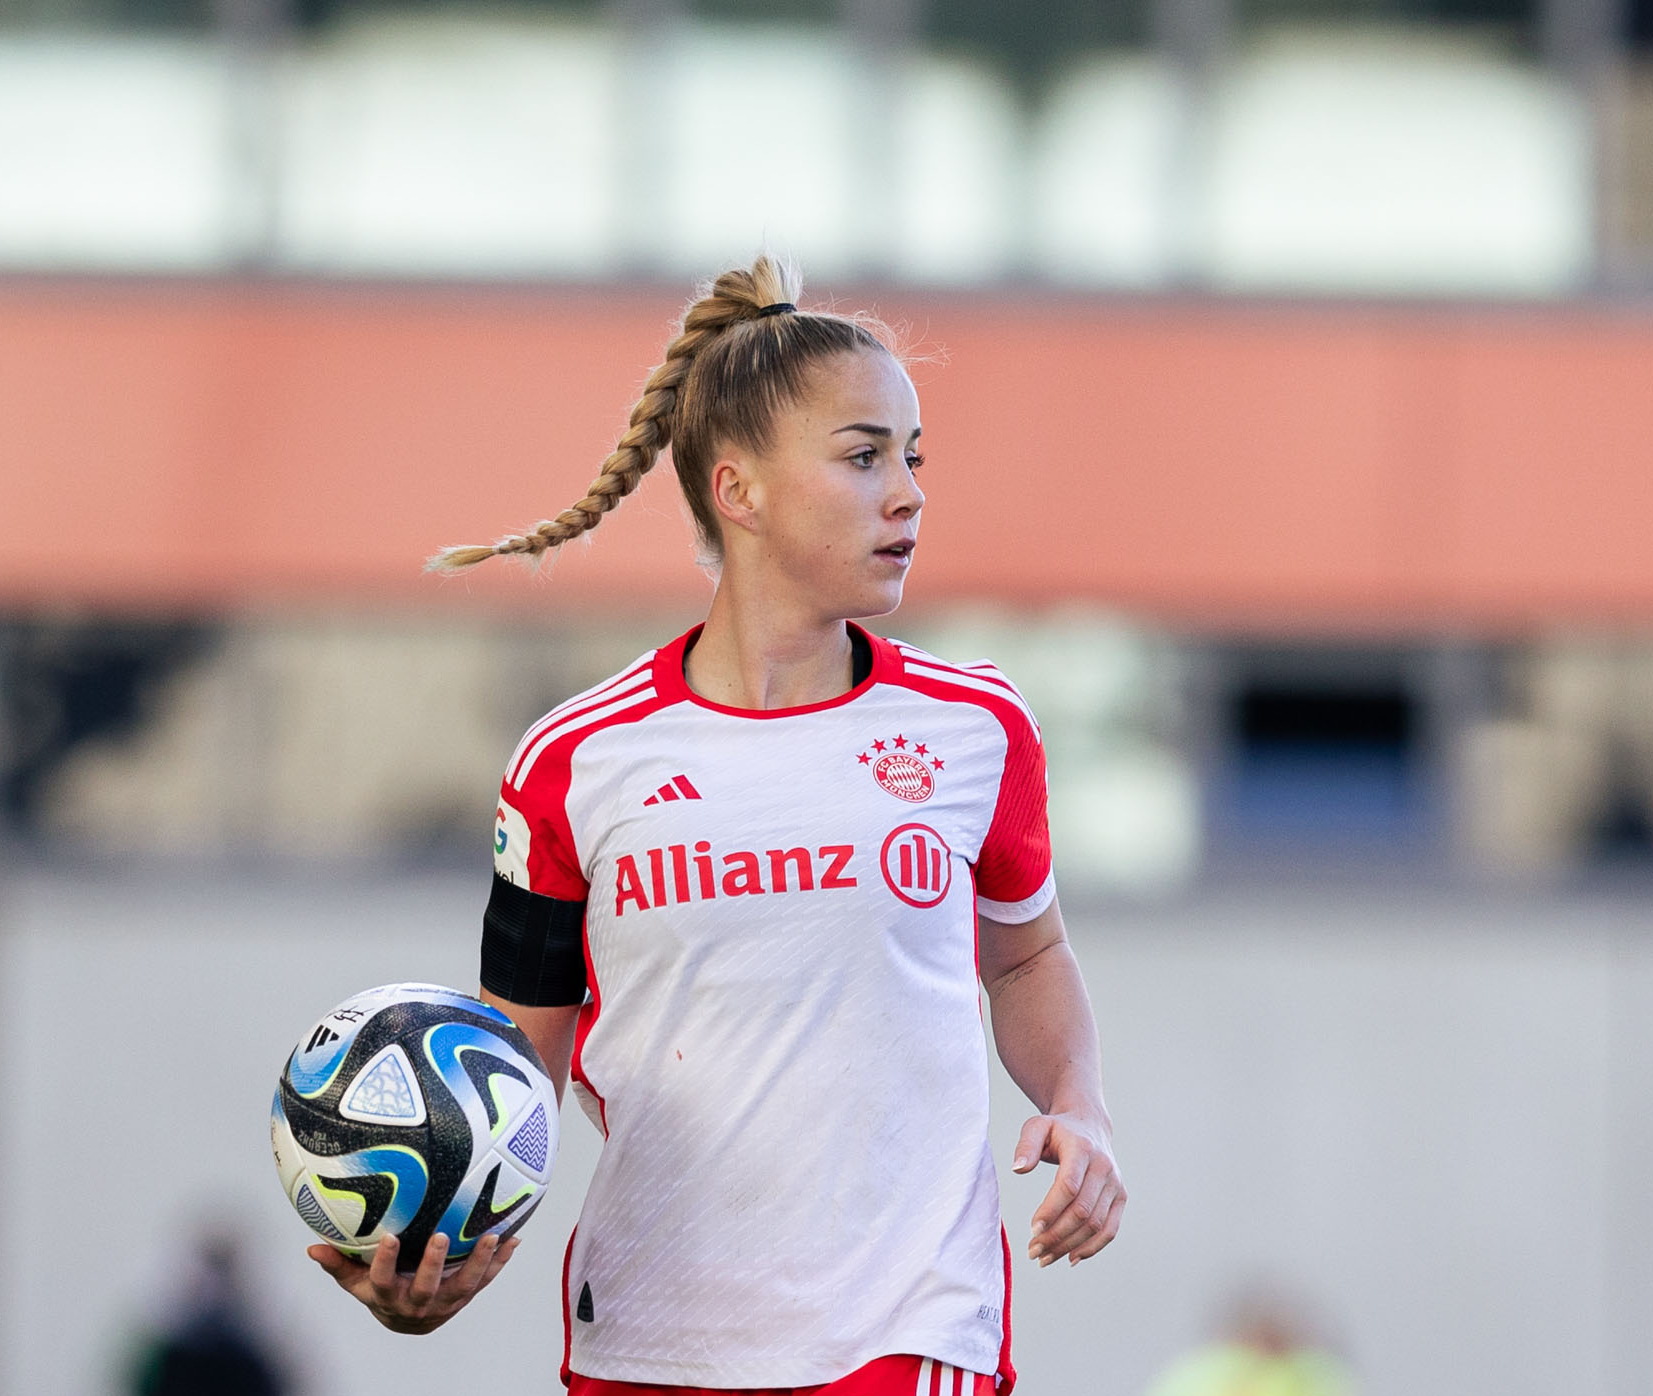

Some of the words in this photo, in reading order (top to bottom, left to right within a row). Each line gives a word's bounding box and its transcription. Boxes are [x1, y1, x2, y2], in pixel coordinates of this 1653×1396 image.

[877, 760, 889, 773] FC
[887, 755, 929, 777] BAYERN
[614, 839, 858, 917] Allianz
